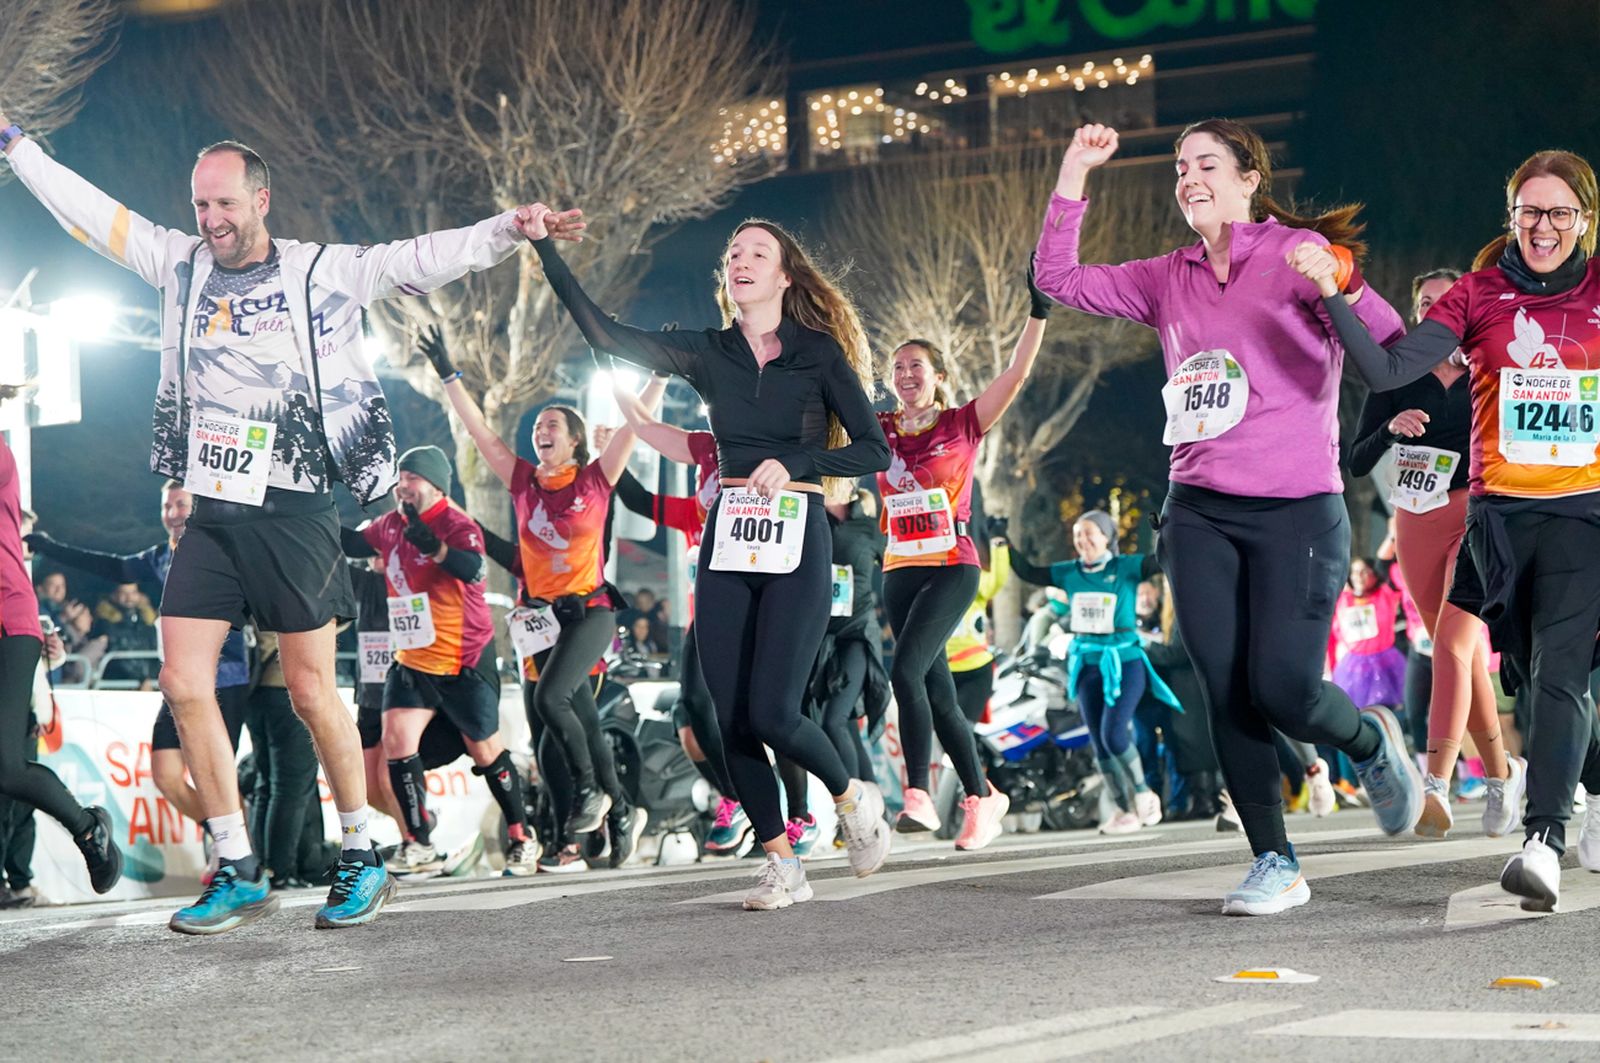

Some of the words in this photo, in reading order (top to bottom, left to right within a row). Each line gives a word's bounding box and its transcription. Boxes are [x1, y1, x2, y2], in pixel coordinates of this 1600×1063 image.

[1182, 360, 1210, 373] NOCHE
[1210, 359, 1220, 369] DE
[1172, 375, 1192, 386] SAN
[1525, 378, 1556, 389] NOCHE
[1559, 379, 1572, 389] DE
[1184, 382, 1231, 412] 1548
[1512, 389, 1534, 400] SAN
[1513, 402, 1594, 433] 12446
[196, 429, 209, 441] SAN
[204, 422, 228, 434] NOCHE
[228, 426, 240, 436] DE
[198, 442, 254, 475] 4502
[897, 476, 916, 492] 43
[1397, 468, 1438, 493] 1496
[735, 496, 759, 506] NOCHE
[760, 497, 772, 506] DE
[726, 506, 741, 516] SAN
[730, 517, 785, 545] 4001
